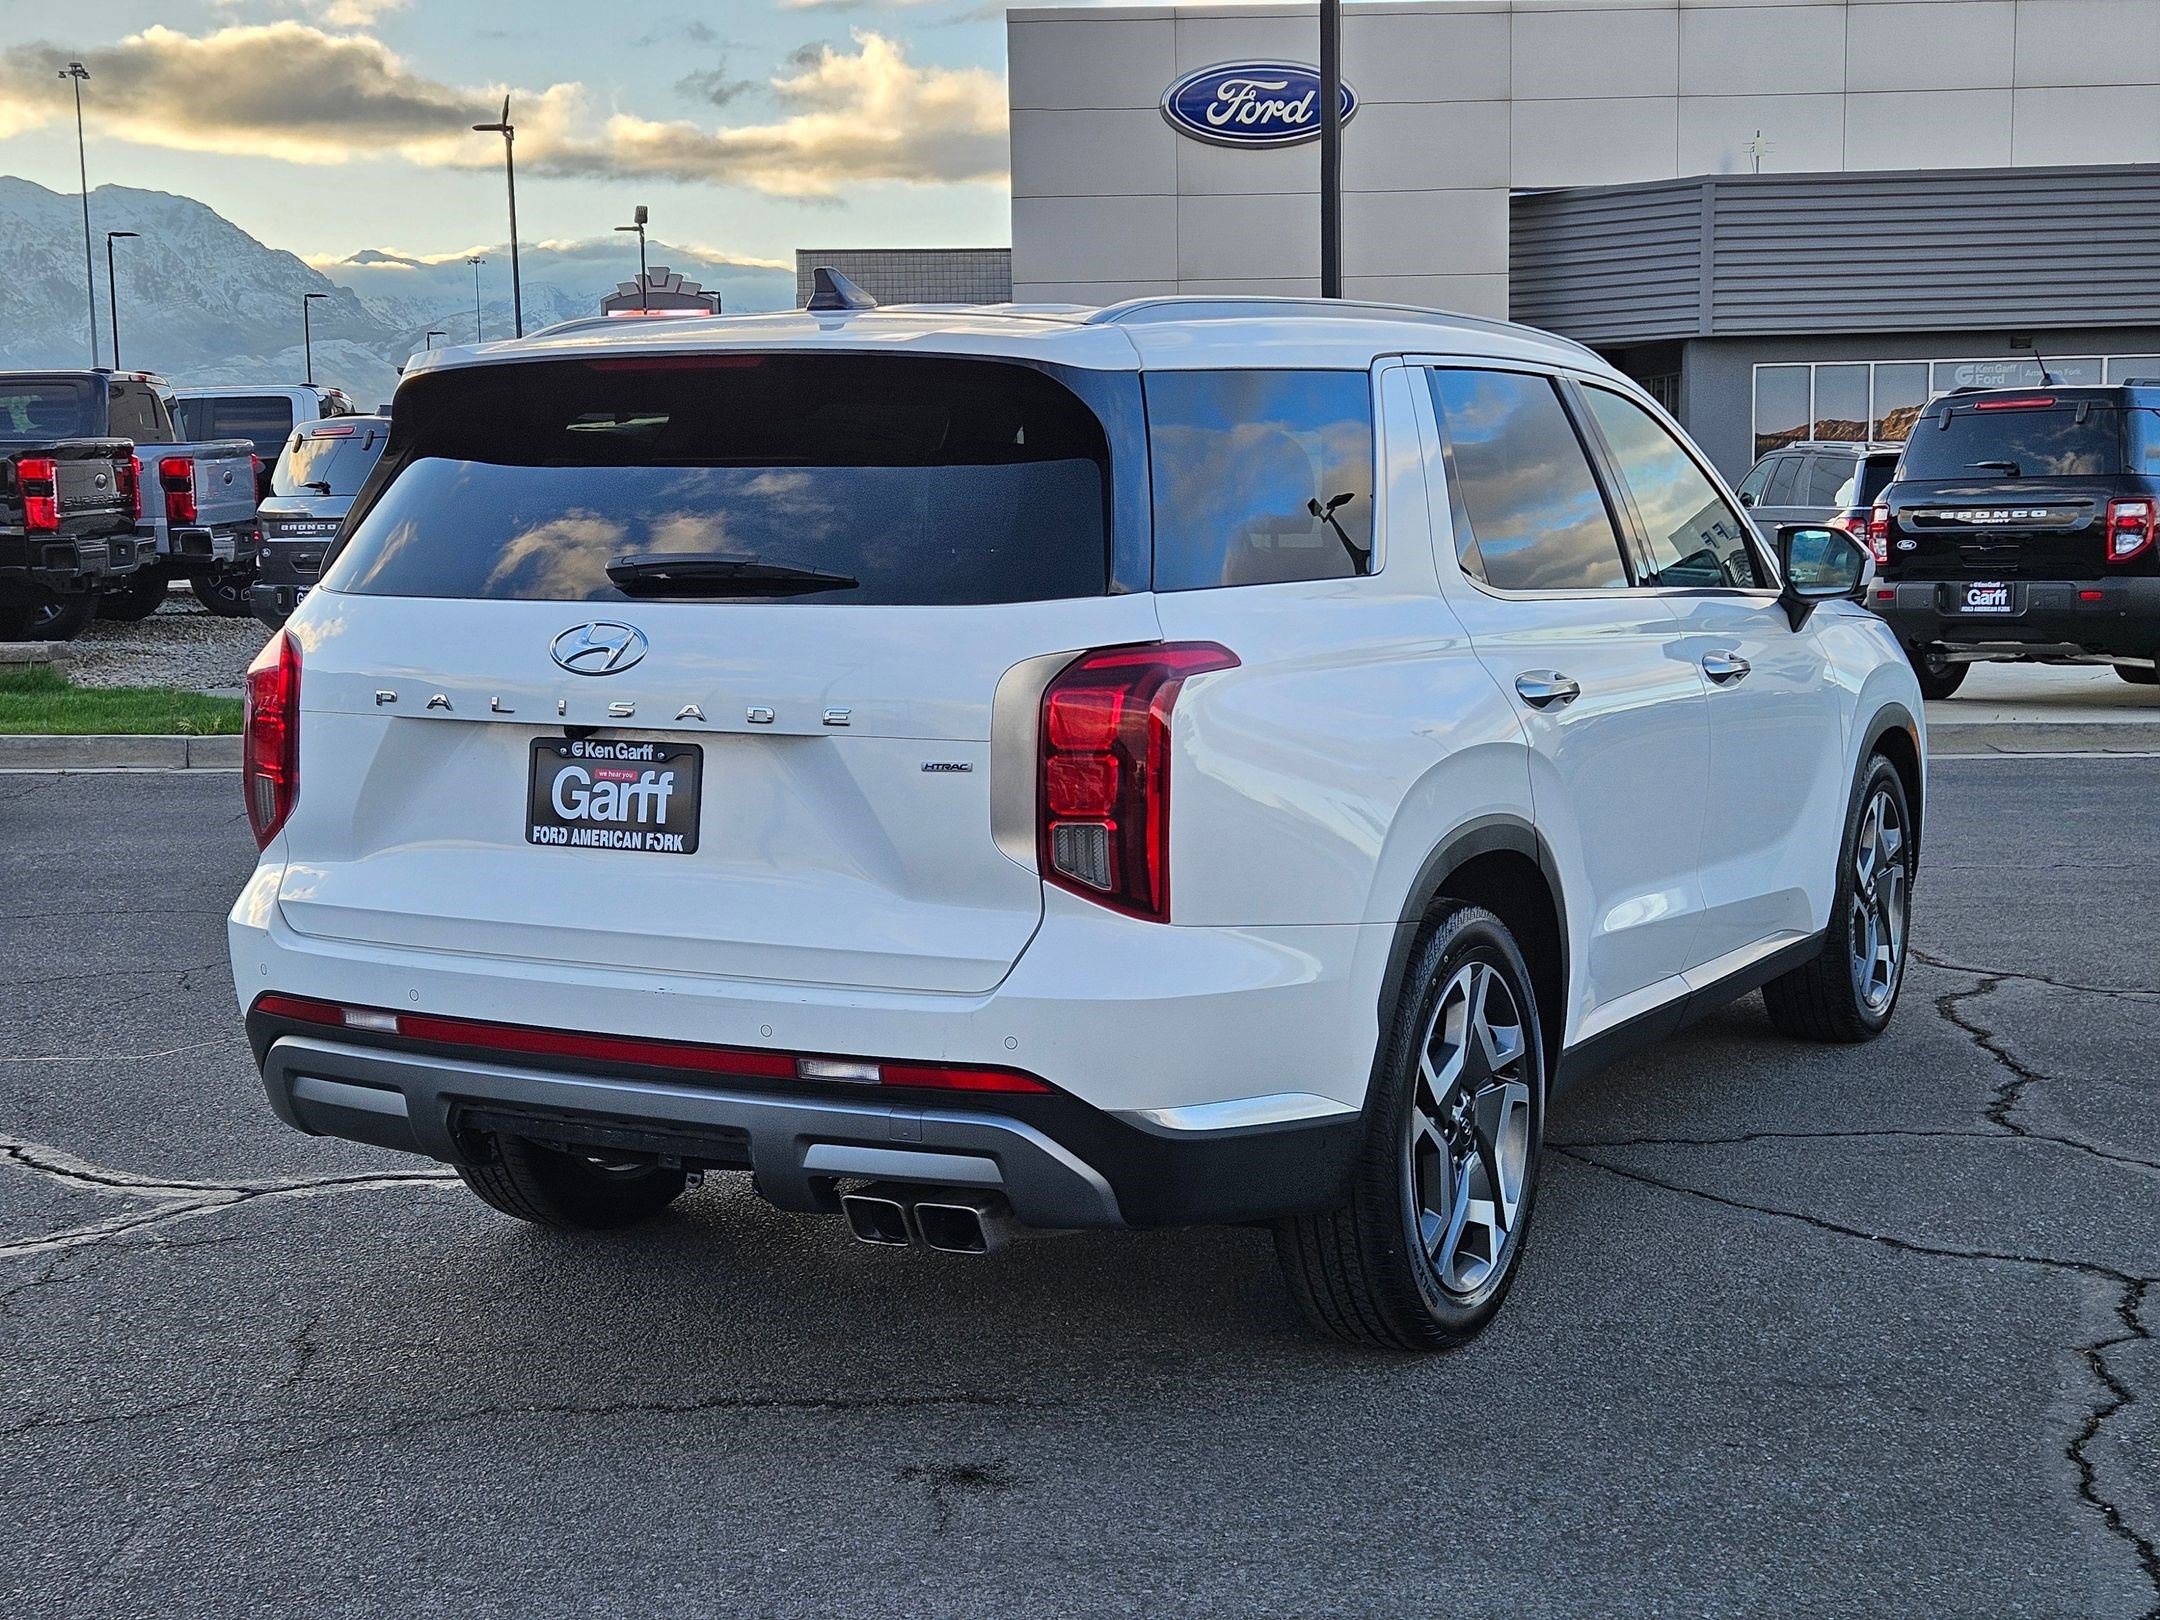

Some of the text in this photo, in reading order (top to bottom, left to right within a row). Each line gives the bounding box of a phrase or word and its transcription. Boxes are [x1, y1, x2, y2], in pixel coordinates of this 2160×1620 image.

[1206, 78, 1316, 126] Ford
[1975, 364, 2017, 374] Ken Garff
[1976, 374, 2006, 385] Ford
[1940, 509, 2048, 520] BRONCO
[1967, 588, 2008, 606] Garff
[375, 689, 852, 727] PALISADE
[585, 741, 654, 760] Ken Garff
[598, 770, 633, 779] we hear you
[924, 763, 969, 771] HTRAC
[551, 765, 674, 825] Garff
[533, 825, 684, 852] FORD AMERICAN FORK
